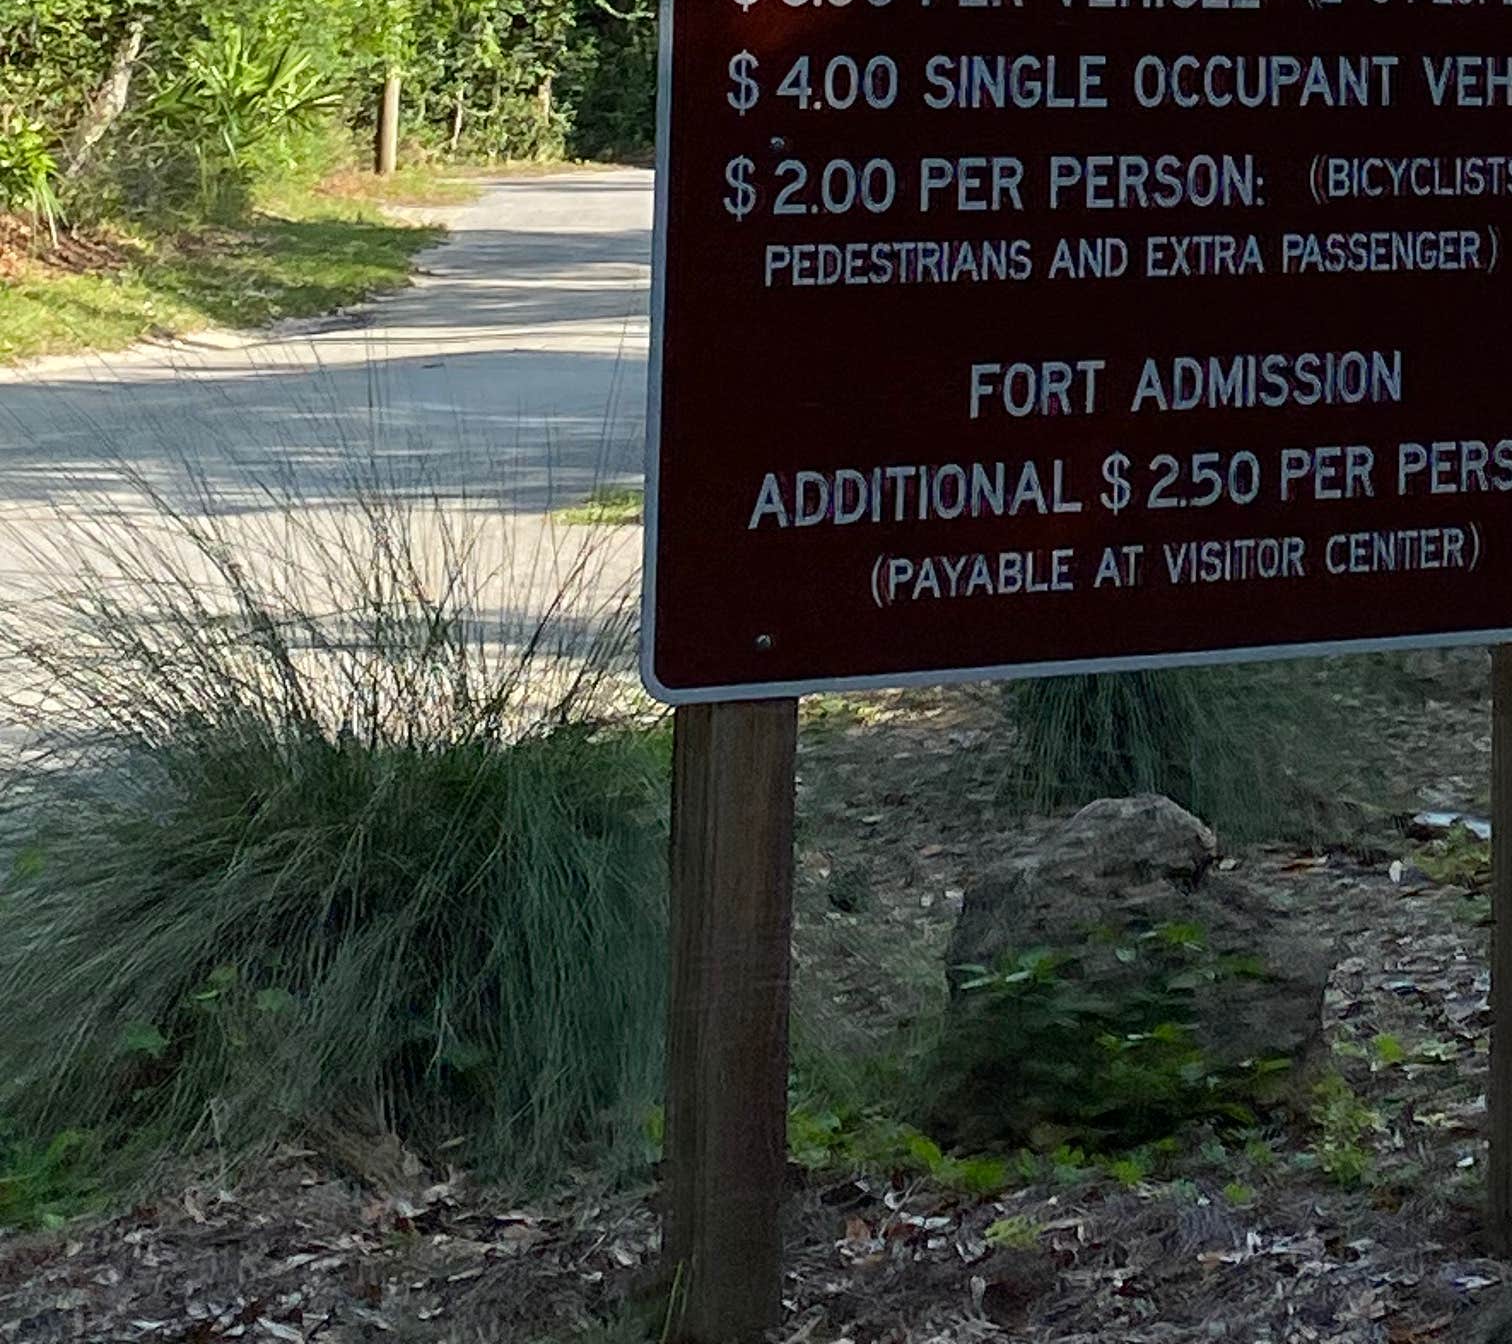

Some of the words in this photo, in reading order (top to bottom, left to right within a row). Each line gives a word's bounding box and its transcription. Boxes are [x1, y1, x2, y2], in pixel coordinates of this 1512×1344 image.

[923, 54, 1108, 110] SINGLE
[1134, 54, 1399, 108] OCCUPANT
[920, 156, 1024, 212] PER
[1049, 154, 1265, 209] PERSON:
[764, 239, 1033, 287] PEDESTRIANS
[1047, 237, 1128, 279] AND
[1146, 234, 1265, 277] EXTRA
[1282, 225, 1498, 274] PASSENGER)
[969, 359, 1106, 419] FORT
[1130, 349, 1402, 412] ADMISSION
[747, 459, 1083, 530] ADDITIONAL
[1280, 445, 1375, 501] PER
[871, 550, 1074, 608] (PAYABLE
[1093, 544, 1144, 588] AT
[1162, 536, 1305, 584] VISITOR
[1325, 522, 1479, 574] CENTER)
